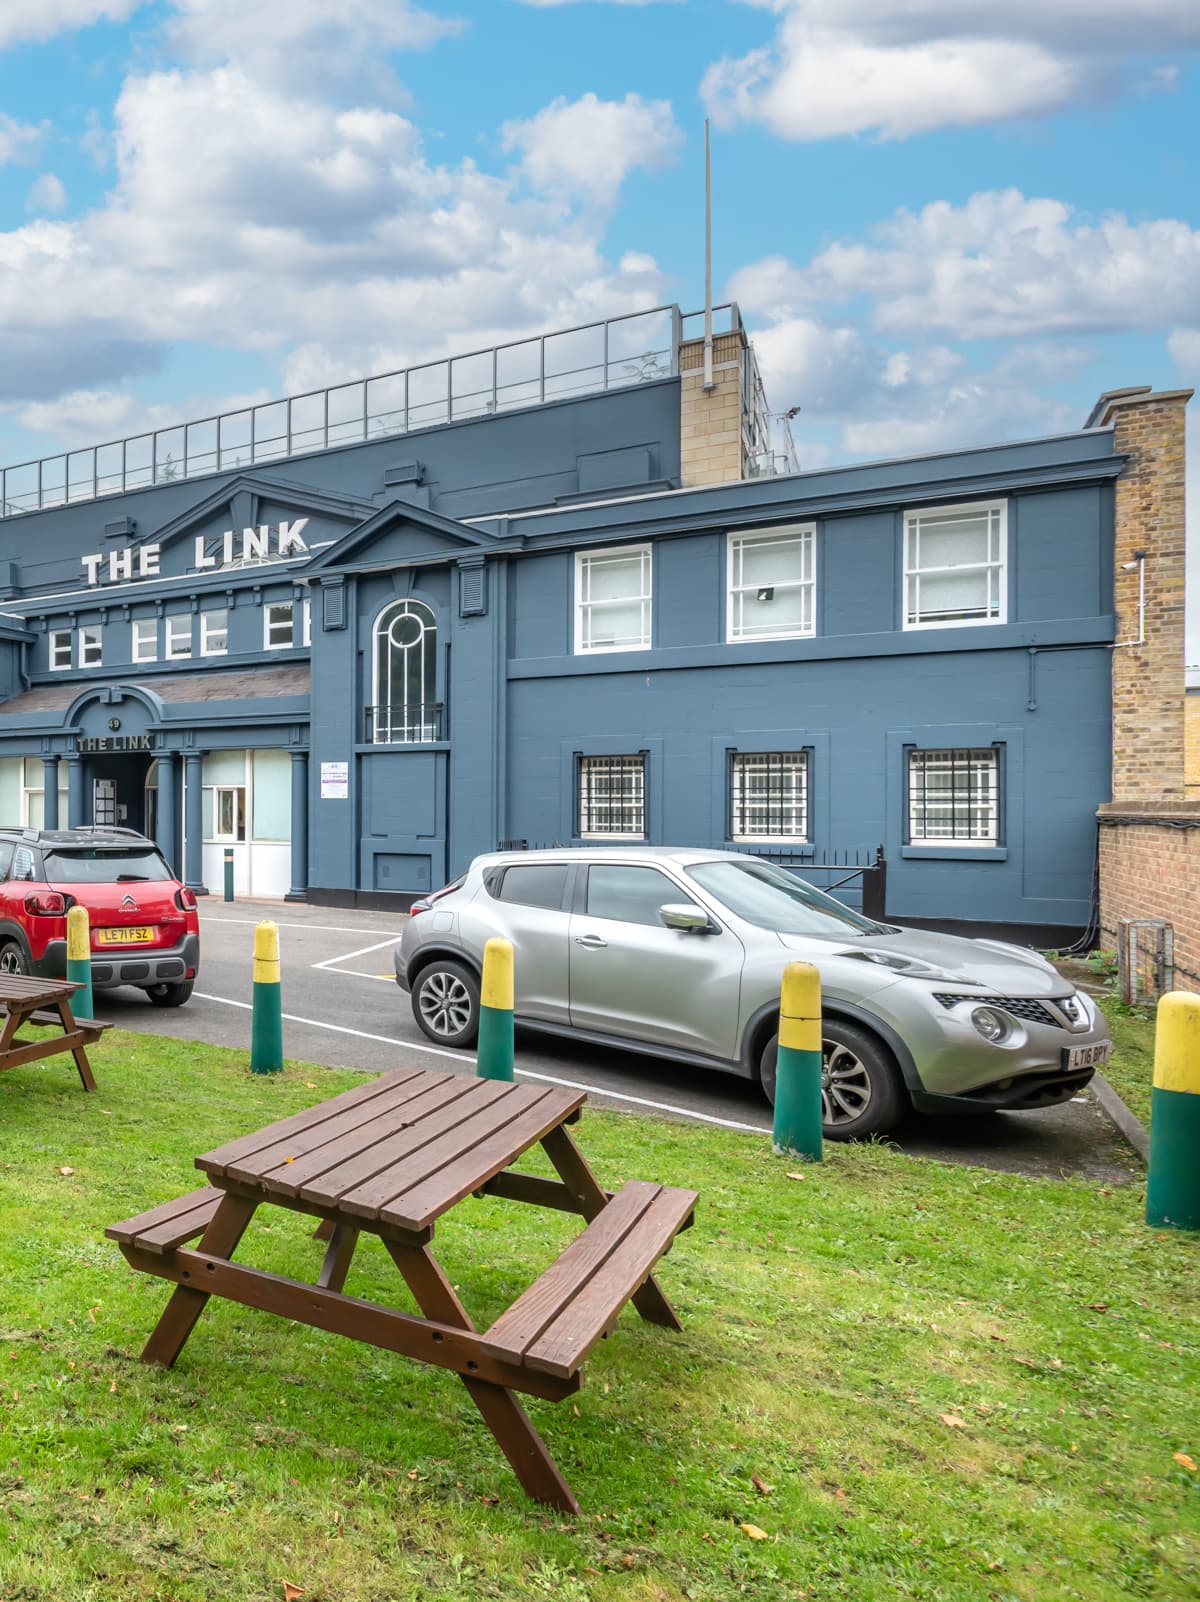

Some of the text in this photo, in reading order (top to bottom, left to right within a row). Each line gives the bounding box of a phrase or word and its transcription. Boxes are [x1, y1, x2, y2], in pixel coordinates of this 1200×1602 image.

[81, 518, 310, 585] THE LINK
[77, 735, 151, 751] THE LINK
[104, 928, 148, 941] LE71 FSZ
[1074, 1044, 1108, 1066] LT16 BPY
